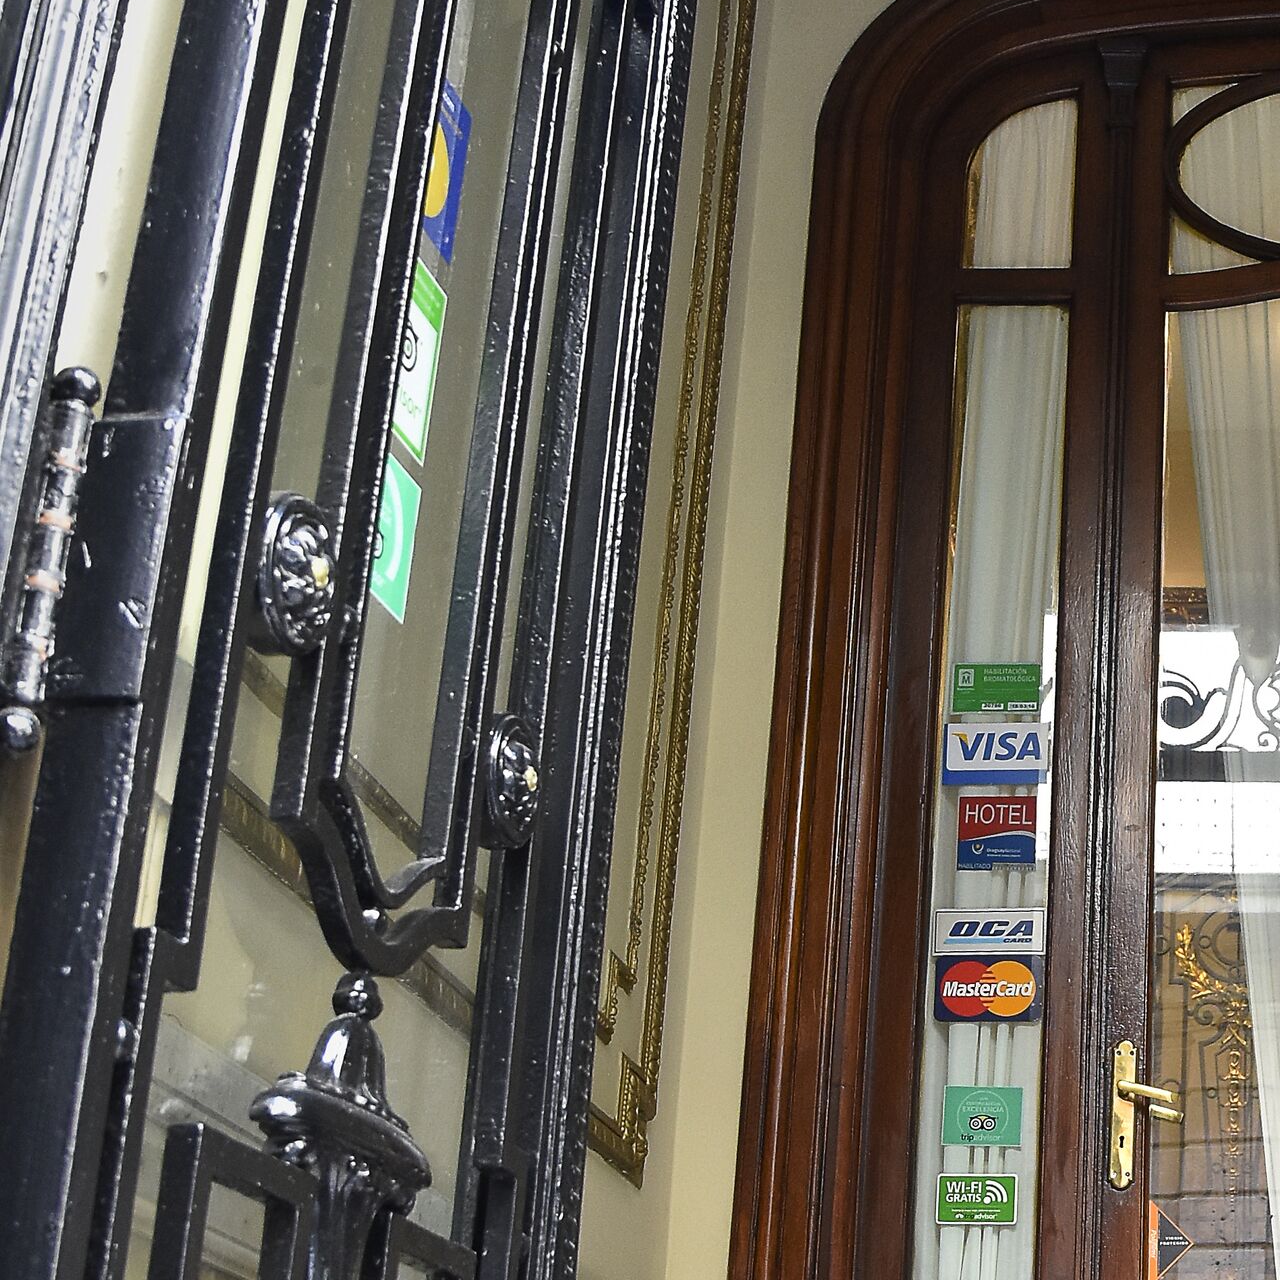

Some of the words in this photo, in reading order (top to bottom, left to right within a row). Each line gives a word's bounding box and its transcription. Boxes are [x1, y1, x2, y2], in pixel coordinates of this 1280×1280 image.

[952, 732, 1042, 761] VISA
[965, 804, 1032, 825] HOTEL
[949, 920, 1034, 936] OCA
[943, 980, 1034, 997] MasterCard
[961, 1133, 1003, 1142] tripadvisor
[946, 1181, 982, 1194] WI-FI
[945, 1193, 982, 1203] GRATIS
